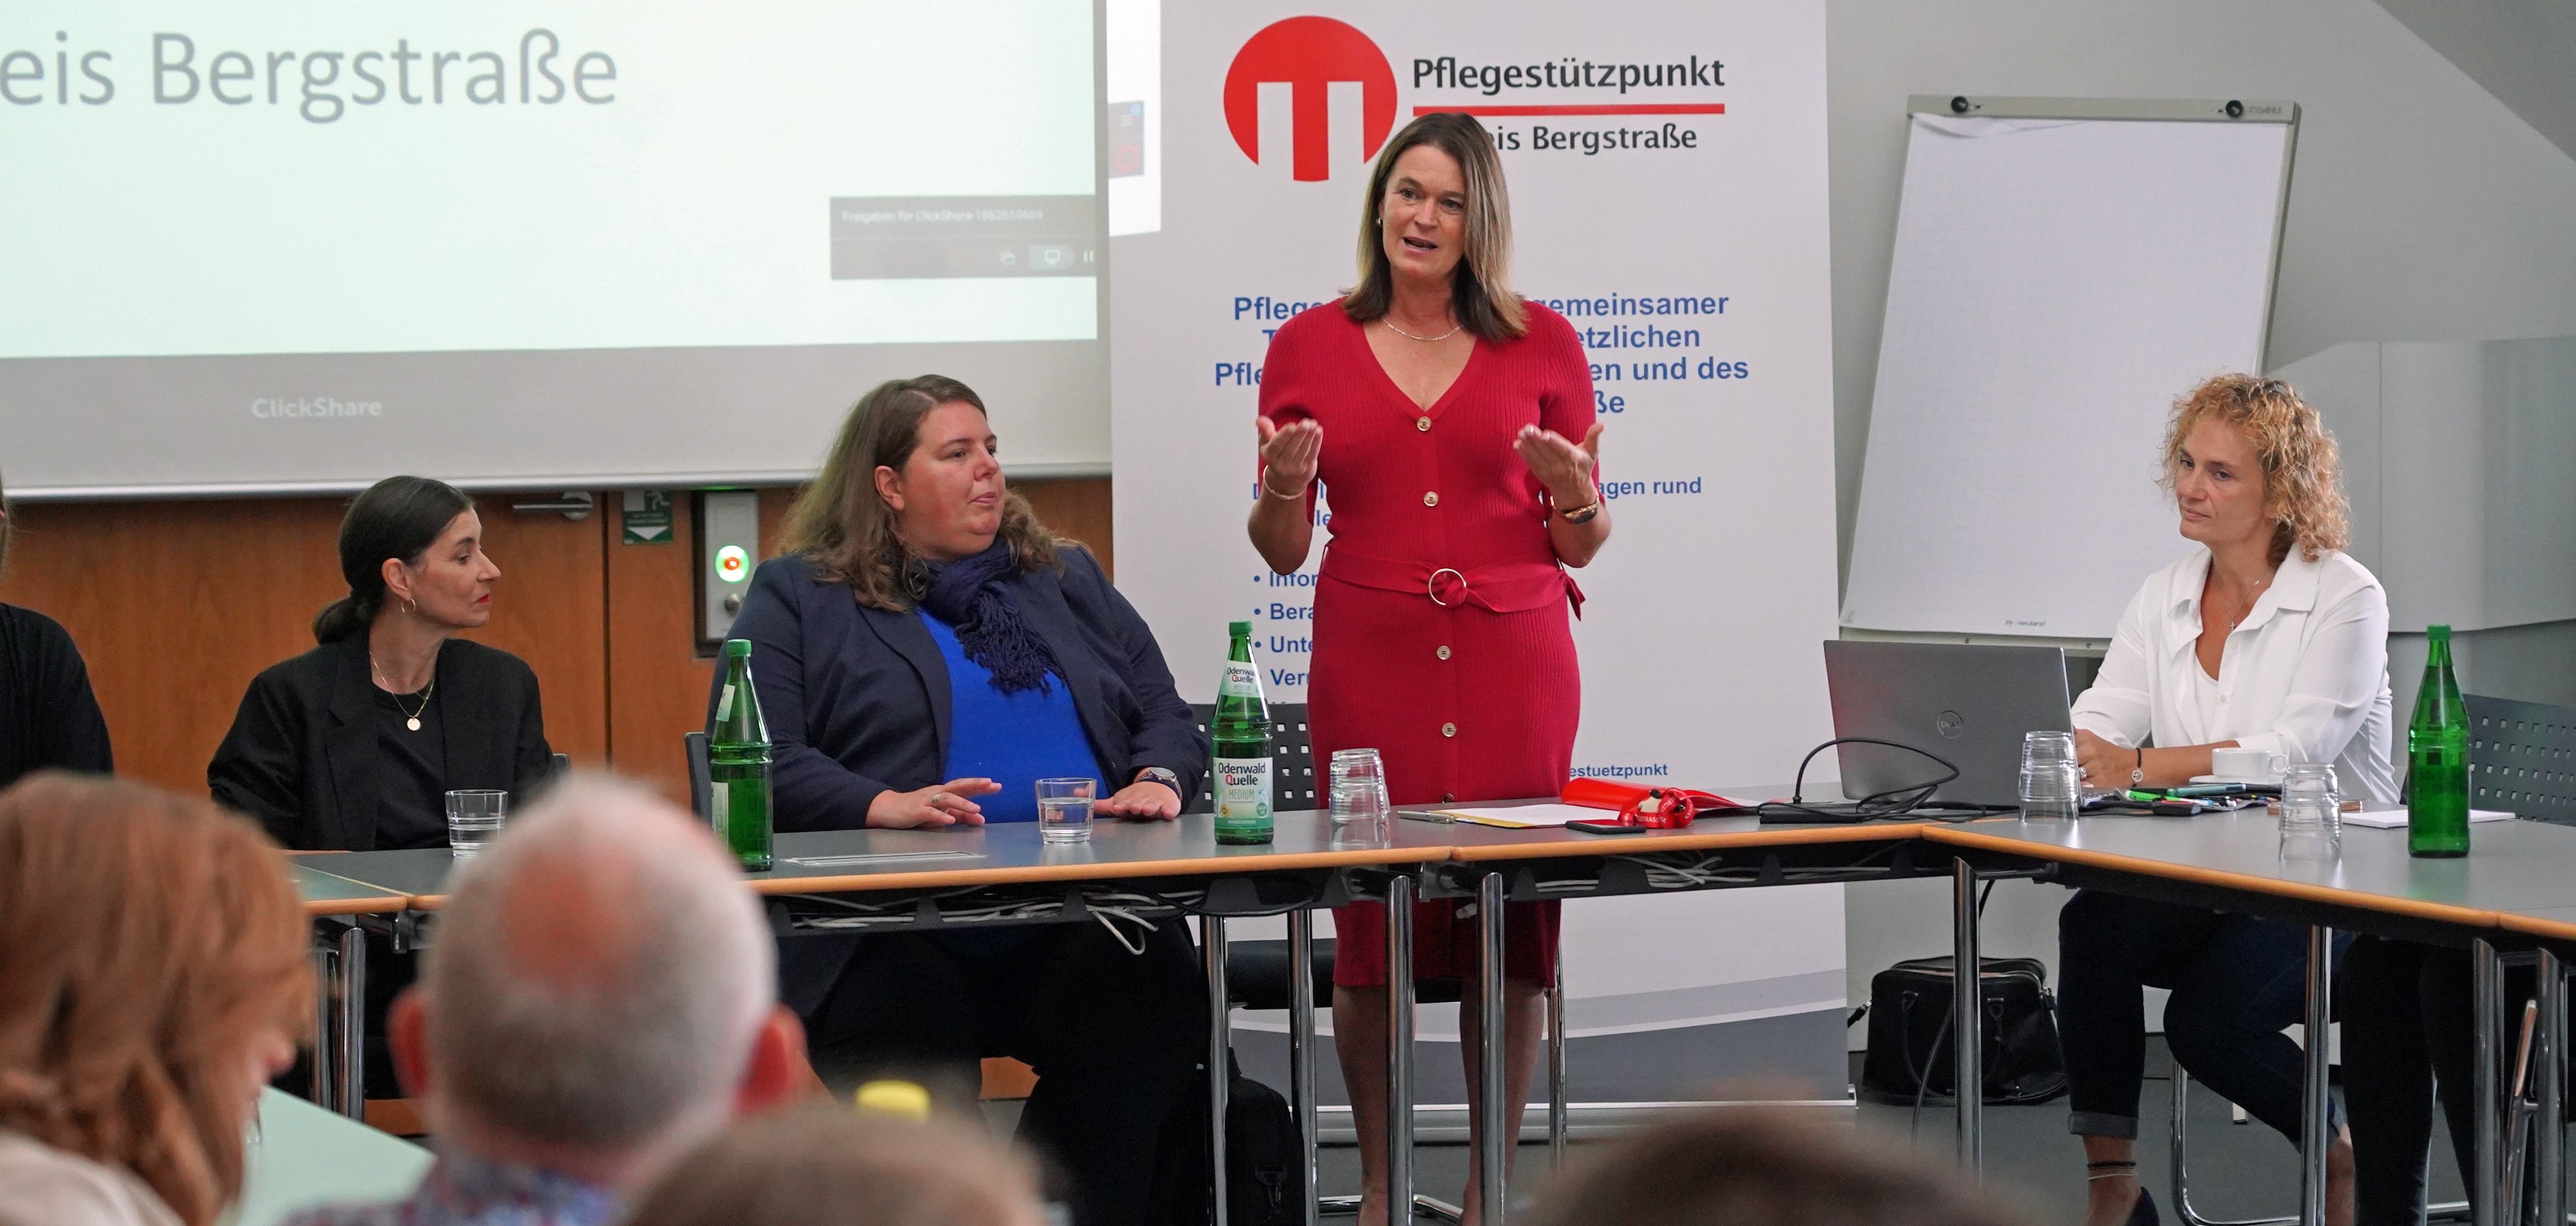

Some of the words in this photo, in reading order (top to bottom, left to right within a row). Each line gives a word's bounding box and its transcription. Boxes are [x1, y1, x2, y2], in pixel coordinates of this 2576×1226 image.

[152, 28, 617, 123] Bergstraße
[1413, 55, 1725, 95] Pflegestützpunkt
[1533, 123, 1697, 155] Bergstraße
[1533, 292, 1729, 316] emeinsamer
[1633, 356, 1687, 381] und
[1697, 355, 1749, 380] des
[251, 397, 383, 419] ClickShare
[1653, 476, 1702, 495] rund
[1218, 762, 1266, 774] Odenwald
[1226, 774, 1258, 786] Quelle
[1228, 788, 1255, 800] MEDIUM
